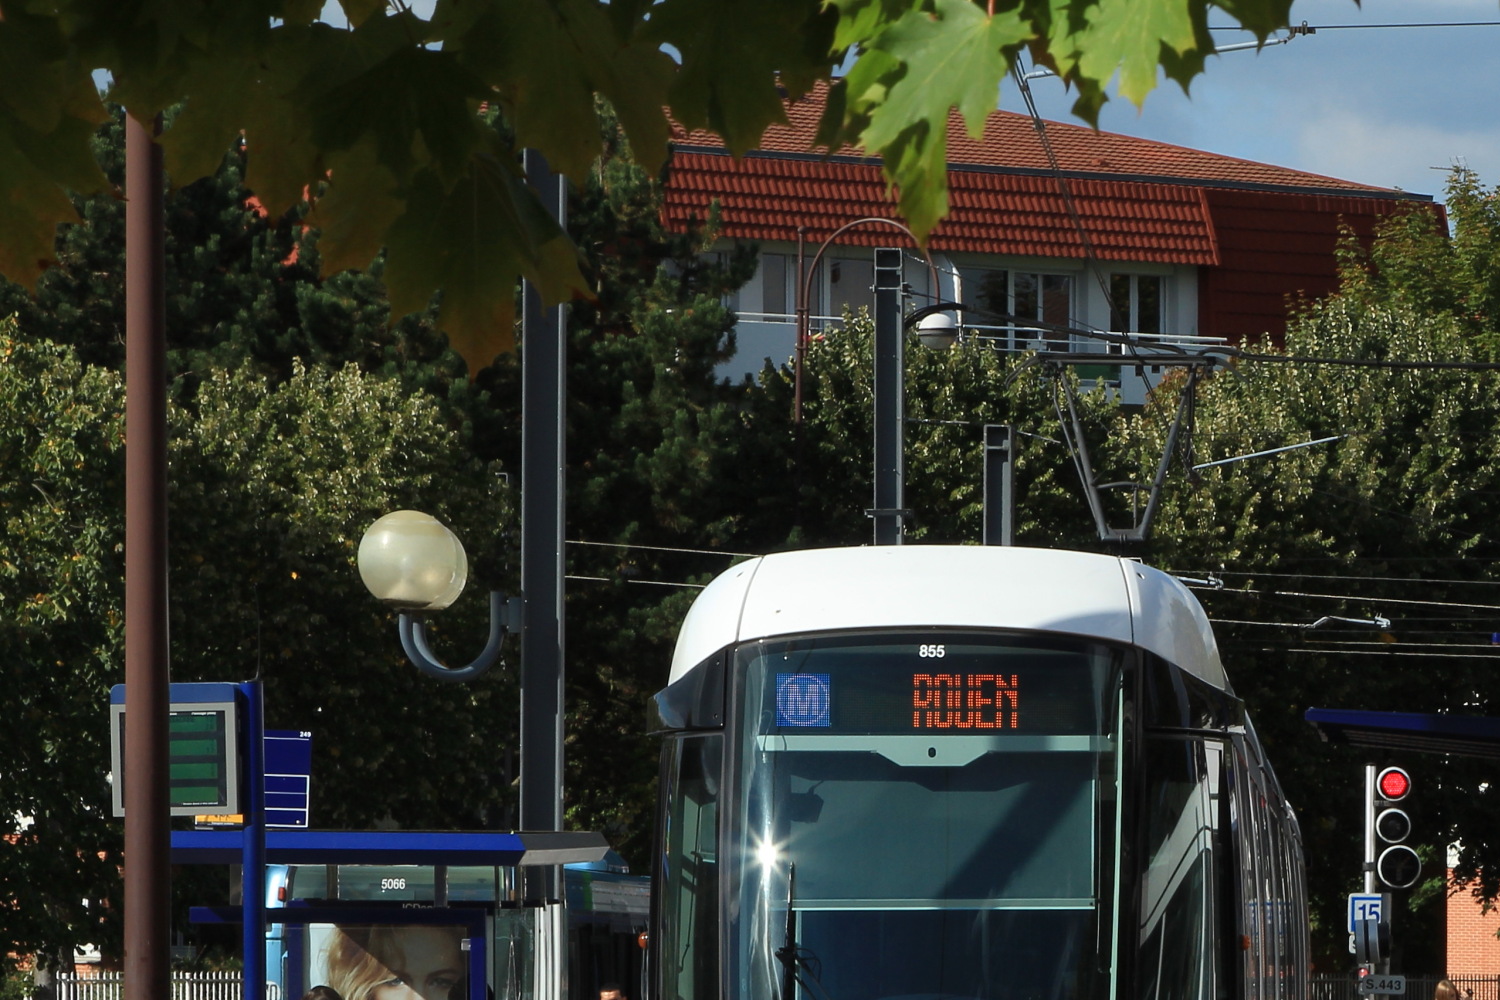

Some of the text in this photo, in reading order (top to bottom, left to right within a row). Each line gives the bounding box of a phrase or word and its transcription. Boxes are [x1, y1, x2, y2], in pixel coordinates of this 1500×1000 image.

[919, 645, 946, 658] 855
[913, 674, 1018, 728] ROUEN
[381, 878, 406, 890] 5066
[1365, 979, 1402, 991] S.443
